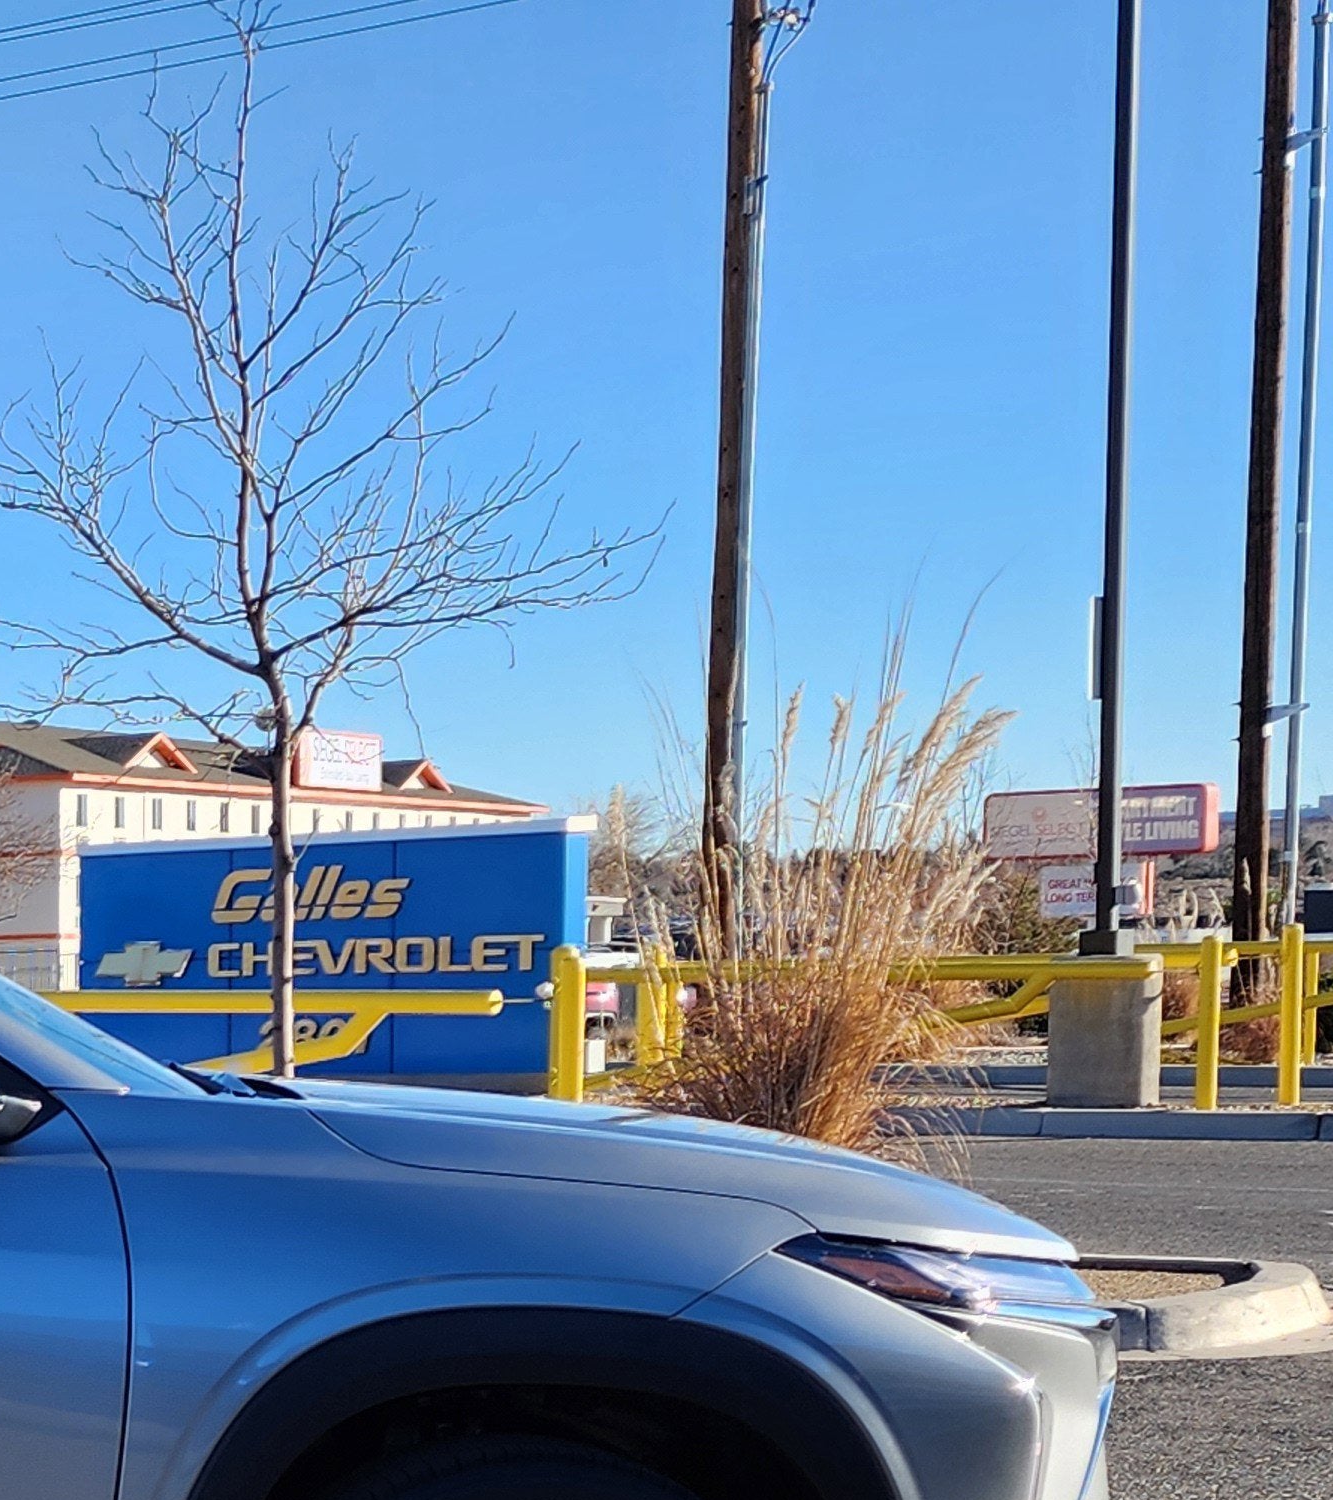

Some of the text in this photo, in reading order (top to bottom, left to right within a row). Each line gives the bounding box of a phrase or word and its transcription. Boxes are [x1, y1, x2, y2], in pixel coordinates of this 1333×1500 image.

[1145, 819, 1200, 840] LIVING
[1047, 878, 1082, 889] GREAT
[1045, 892, 1073, 903] LONG
[207, 934, 545, 978] CHEVROLET
